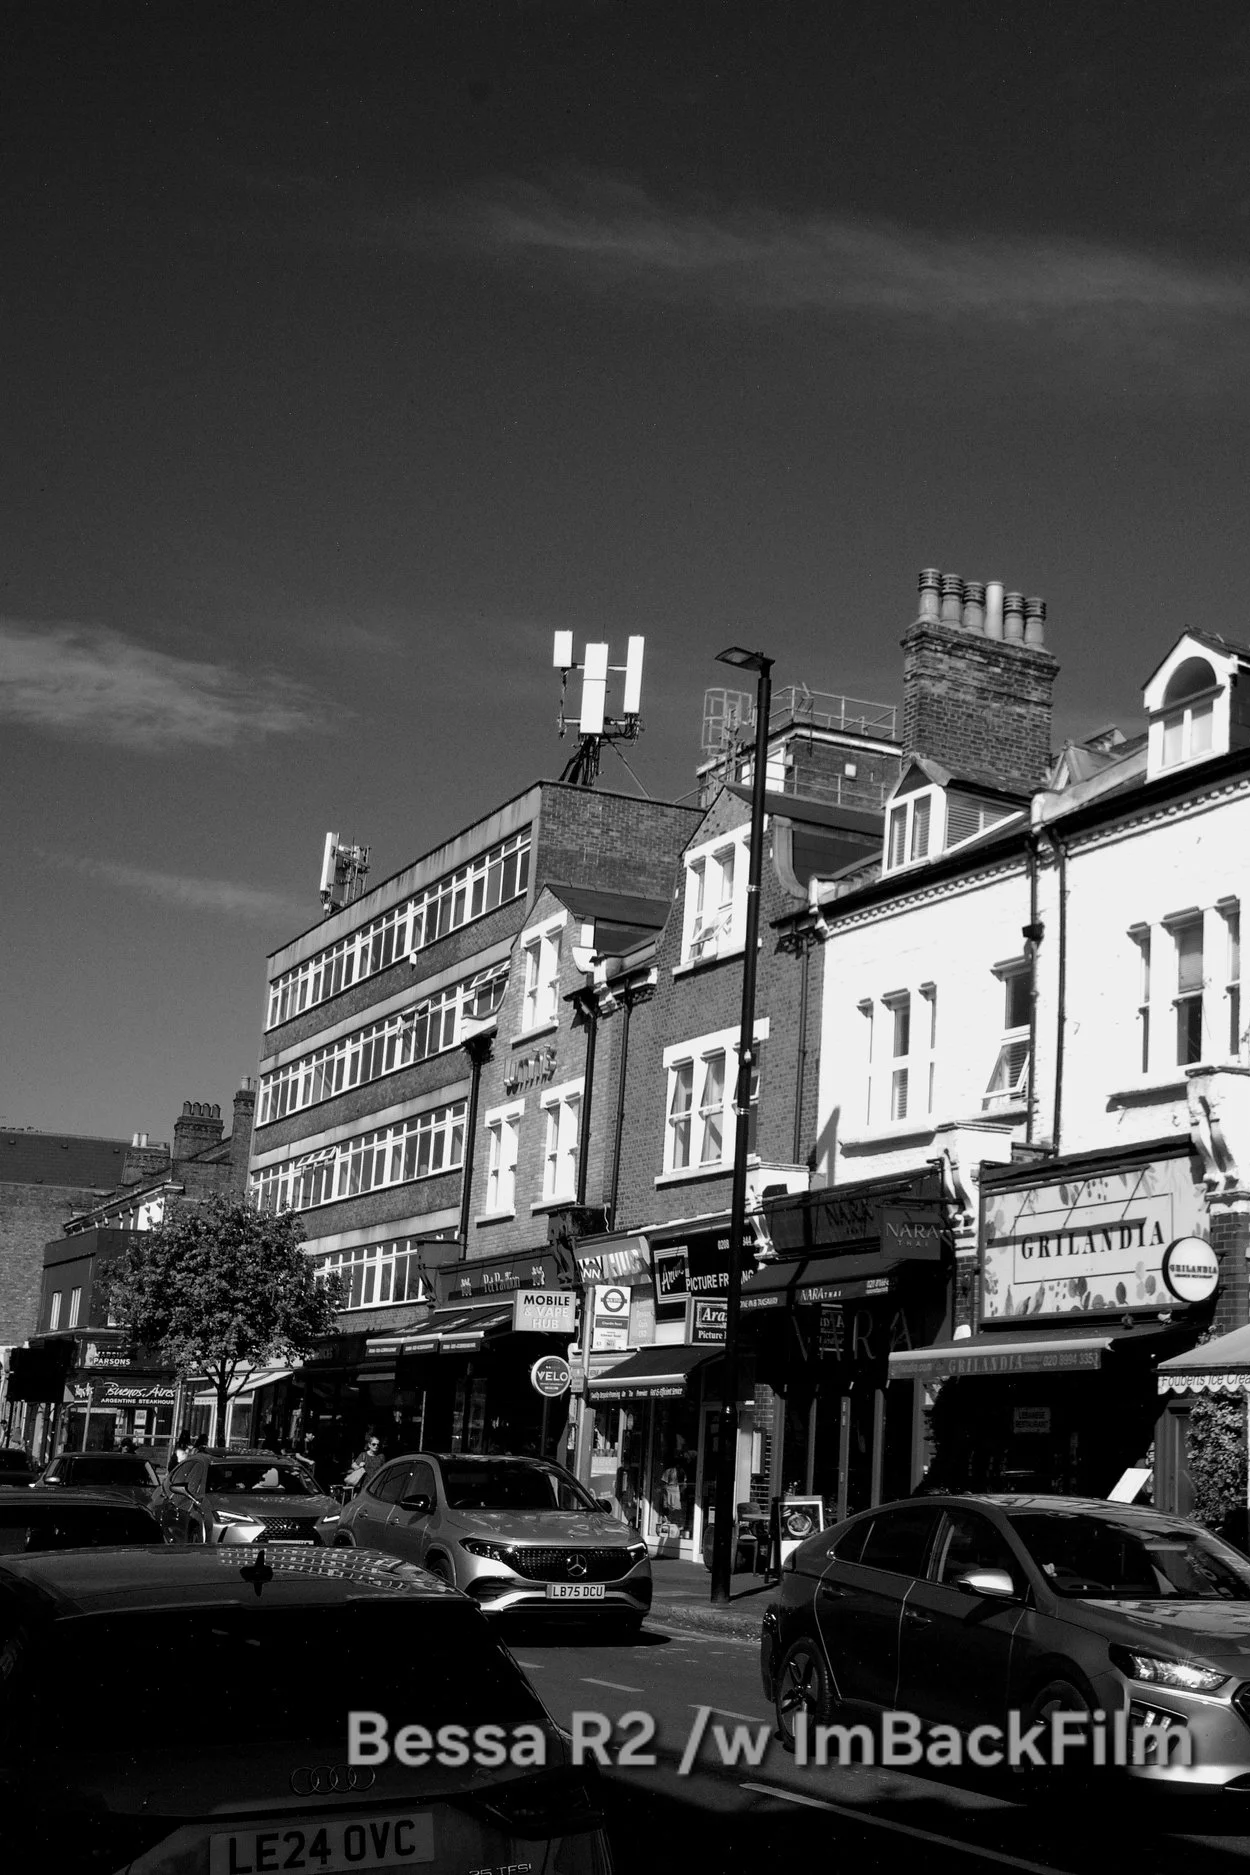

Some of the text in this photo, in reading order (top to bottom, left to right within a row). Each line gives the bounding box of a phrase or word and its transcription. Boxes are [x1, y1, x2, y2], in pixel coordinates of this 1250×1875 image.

[885, 1222, 940, 1239] NARA
[897, 1240, 929, 1248] THAI
[1020, 1221, 1166, 1261] GRILANDIA
[1168, 1264, 1218, 1275] GRILANDIA
[685, 1274, 718, 1292] PICTURE
[800, 1287, 824, 1301] NARA
[523, 1295, 570, 1306] MOBILE
[535, 1307, 569, 1318] VAPE
[702, 1307, 727, 1322] Ara
[532, 1319, 560, 1329] HUB
[698, 1329, 723, 1340] Picture
[93, 1358, 131, 1366] PARSONS
[949, 1354, 1024, 1374] GRILANDIA
[537, 1371, 569, 1382] VELO
[1207, 1375, 1224, 1386] Ice
[552, 1585, 604, 1598] LB75 DCU
[228, 1820, 417, 1875] LE24 OVC
